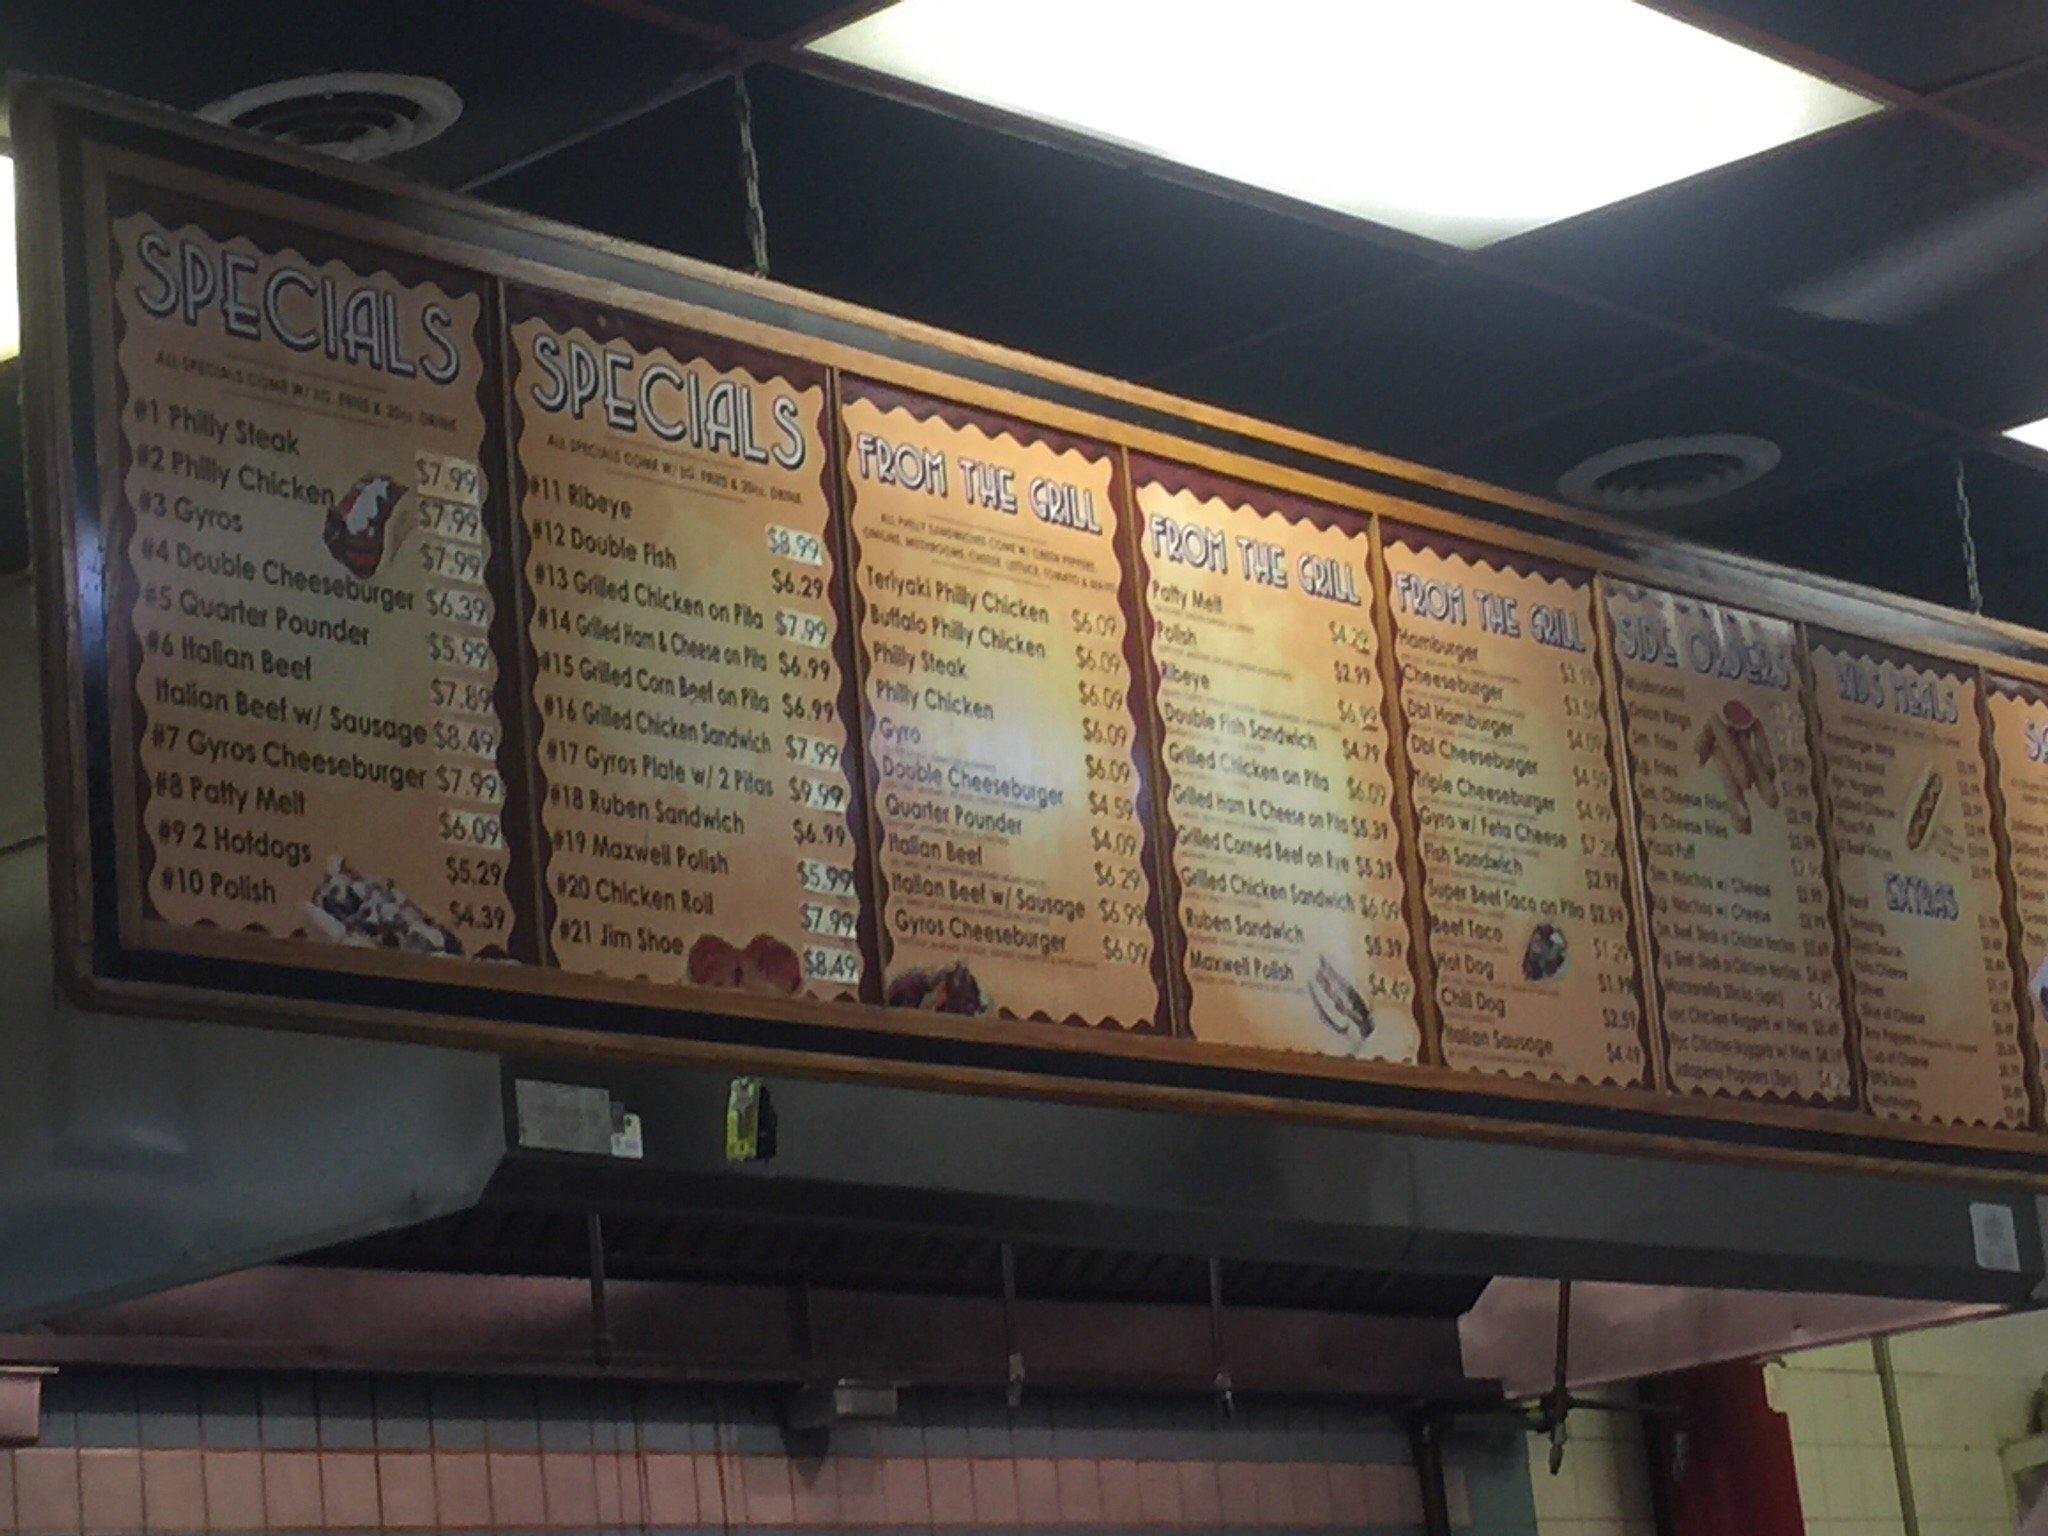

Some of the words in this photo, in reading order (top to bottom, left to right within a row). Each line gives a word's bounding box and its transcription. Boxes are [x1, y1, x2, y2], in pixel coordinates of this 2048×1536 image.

[136, 229, 460, 384] SPECIALS
[531, 332, 806, 472] SPECIALS
[134, 399, 158, 423] #1
[169, 404, 229, 444] Philly
[235, 418, 300, 455] Steak
[137, 444, 165, 471] #2
[172, 450, 230, 489] Philly
[238, 464, 335, 507] Chicken
[416, 458, 477, 494] $7.99
[857, 431, 949, 500] FROM
[957, 456, 1018, 515] THE
[1028, 476, 1103, 536] GRILL
[140, 489, 166, 518] #3
[174, 496, 243, 533] Gyros
[418, 500, 479, 538] $7.99
[530, 475, 561, 502] #11
[567, 482, 633, 521] Ribeye
[419, 542, 481, 578] $7.99
[532, 518, 565, 547] #12
[570, 525, 638, 562] Double
[643, 543, 677, 570] Fish
[1150, 513, 1228, 575] FROM
[1235, 535, 1288, 590] THE
[1298, 552, 1361, 607] GRILL
[142, 535, 169, 564] #4
[176, 541, 256, 583] Double
[262, 558, 415, 613] Cheeseburger
[771, 566, 824, 600] $6.29
[145, 582, 172, 611] #5
[179, 588, 266, 628] Quarter
[275, 605, 370, 646] Pounder
[424, 587, 487, 626] $6.39
[535, 561, 568, 592] #13
[634, 582, 703, 621] Chicken
[708, 603, 730, 621] on
[733, 602, 764, 630] Pita
[1396, 570, 1467, 627] FROM
[1473, 588, 1520, 639] THE
[1529, 601, 1586, 653] GRILL
[538, 605, 571, 634] #14
[774, 609, 828, 643] $7.99
[148, 630, 173, 657] #6
[181, 635, 254, 672] Italian
[261, 648, 312, 680] Beef
[427, 631, 489, 669] $5.99
[778, 650, 832, 682] $6.99
[156, 678, 228, 714] Italian
[235, 691, 287, 722] Beef
[292, 703, 321, 731] w/
[329, 706, 428, 748] Sausage
[782, 692, 834, 721] $6.99
[433, 718, 495, 754] $8.49
[785, 734, 839, 767] $7.99
[878, 716, 921, 744] Gyro
[152, 724, 180, 748] #7
[187, 728, 256, 764] Gyros
[262, 741, 428, 791] Cheeseburger
[545, 739, 579, 764] #17
[584, 745, 636, 776] Gyros
[642, 753, 686, 784] Plate
[692, 767, 712, 791] w/
[718, 767, 729, 790] 2
[734, 769, 774, 797] Pitas
[156, 772, 182, 799] #8
[190, 775, 248, 813] Patty
[255, 786, 306, 816] Melt
[436, 764, 499, 801] $7.99
[789, 775, 844, 808] $9.99
[882, 755, 942, 785] Double
[948, 765, 1064, 809] Cheeseburger
[439, 810, 500, 845] $6.09
[550, 783, 584, 811] #18
[589, 788, 650, 819] Ruben
[654, 799, 746, 836] Sandwich
[885, 792, 949, 824] Quarter
[955, 804, 1023, 837] Pounder
[158, 819, 185, 846] #9
[192, 821, 208, 850] 2
[214, 826, 311, 867] Hotdogs
[553, 829, 587, 856] #19
[592, 833, 672, 868] Maxwell
[676, 844, 730, 875] Polish
[793, 818, 846, 847] $6.99
[162, 865, 201, 895] #10
[210, 870, 276, 904] Polish
[445, 855, 501, 888] $5.29
[797, 859, 852, 893] $5.99
[557, 874, 590, 900] #20
[596, 877, 676, 912] Chicken
[680, 888, 714, 915] Roll
[560, 918, 592, 944] #21
[601, 923, 632, 950] Jim
[637, 927, 684, 956] Shoe
[801, 902, 853, 935] $7.99
[895, 908, 944, 936] Gyros
[949, 916, 1067, 955] Cheeseburger
[803, 947, 858, 978] $8.49
